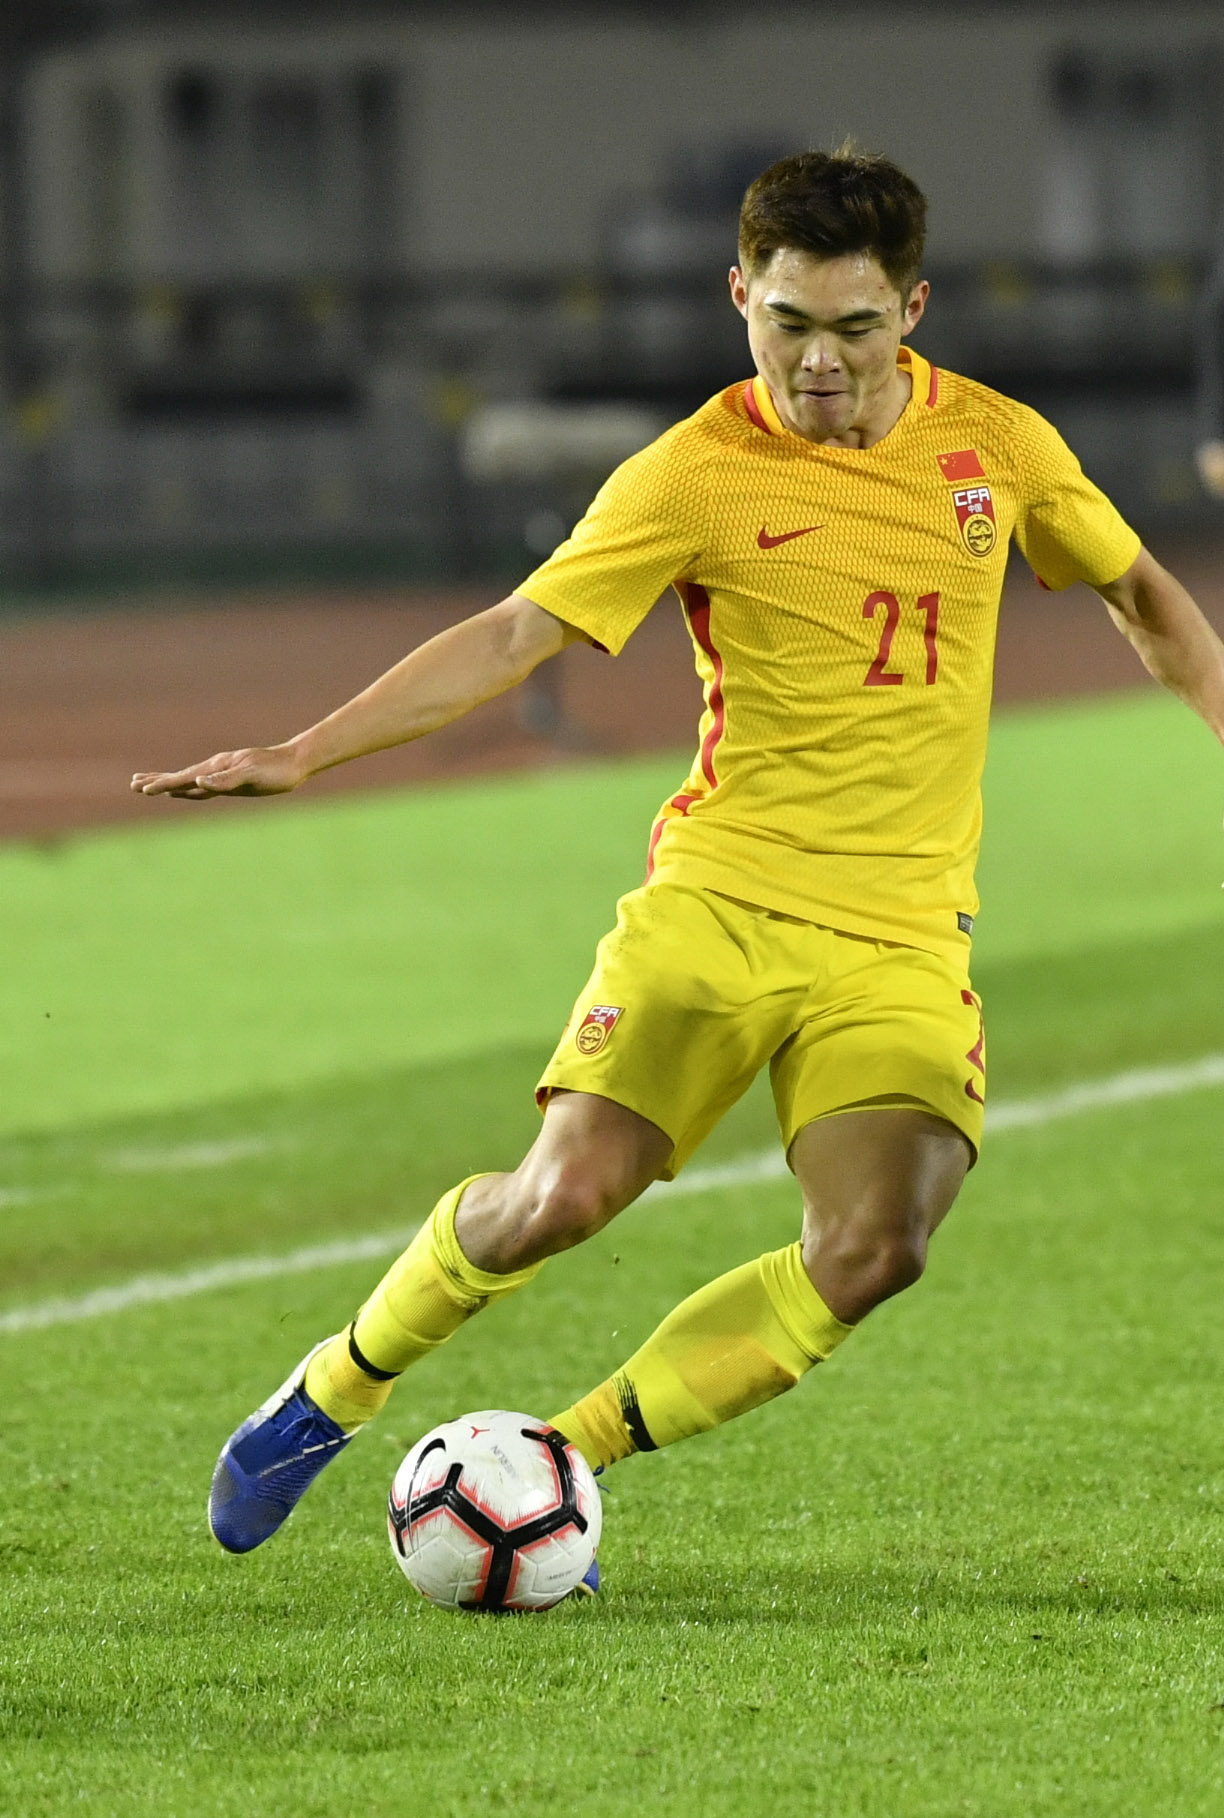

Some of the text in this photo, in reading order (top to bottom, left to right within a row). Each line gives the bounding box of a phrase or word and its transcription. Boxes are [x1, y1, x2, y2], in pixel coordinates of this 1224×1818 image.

[954, 487, 990, 507] CFA
[862, 590, 940, 687] 21
[589, 1006, 620, 1018] CFA
